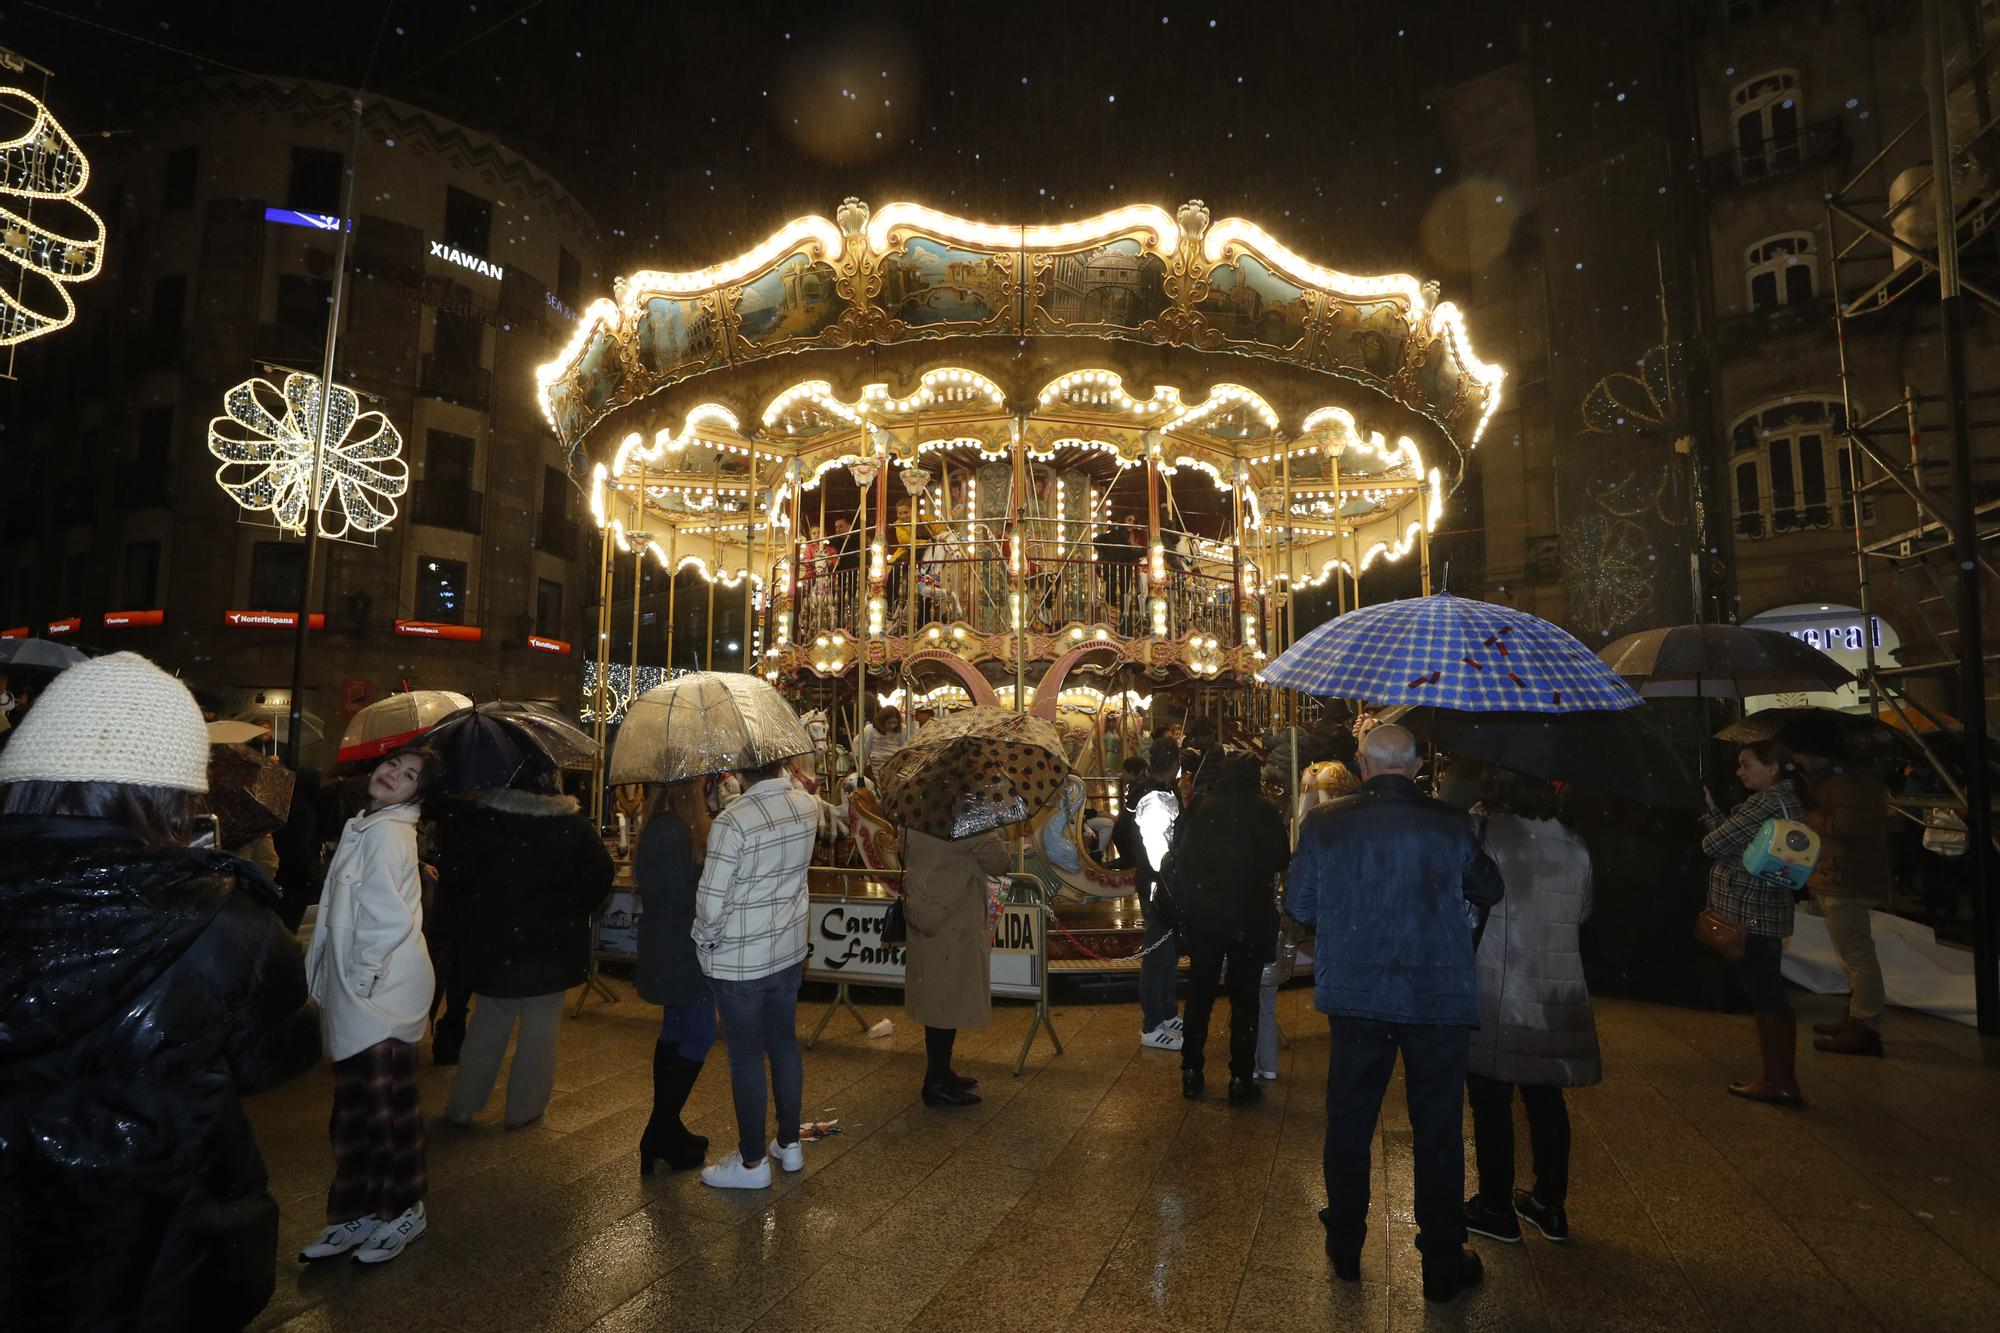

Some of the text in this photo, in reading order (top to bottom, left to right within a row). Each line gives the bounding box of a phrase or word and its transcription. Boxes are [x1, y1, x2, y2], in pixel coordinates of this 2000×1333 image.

[430, 240, 504, 281] XIAWAN
[545, 291, 563, 314] SEA
[240, 615, 294, 625] NorteHispana
[1786, 617, 1881, 650] eral
[821, 907, 885, 941] Carr
[992, 913, 1034, 950] LIDA
